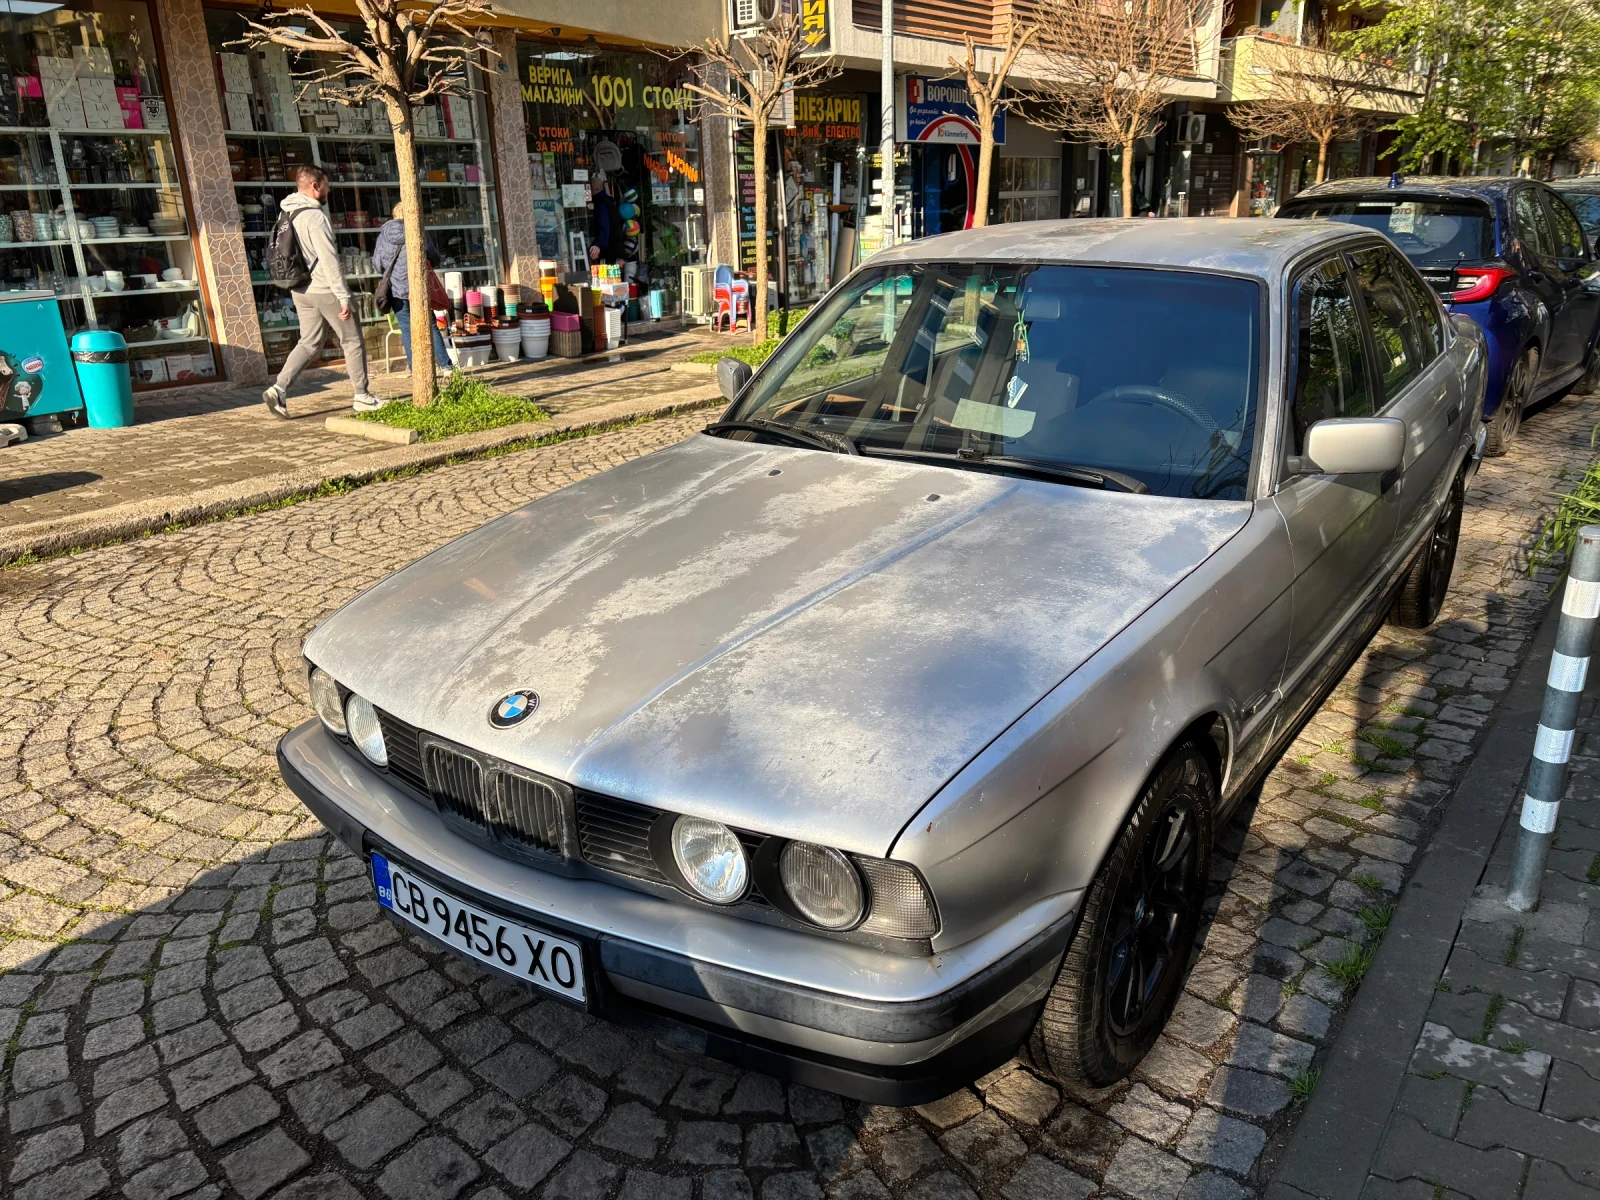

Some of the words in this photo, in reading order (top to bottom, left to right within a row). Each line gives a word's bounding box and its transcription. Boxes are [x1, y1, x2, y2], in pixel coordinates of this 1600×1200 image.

[803, 0, 826, 31] ИЯ
[528, 65, 574, 86] ВЕРИГА
[521, 84, 583, 106] МАГАЗИНИ
[591, 74, 634, 108] 1001
[643, 85, 693, 111] СТОКИ
[927, 85, 977, 105] ВОРОШИ
[794, 96, 861, 123] ЕЛЕЗАРИЯ
[538, 126, 570, 139] СТОКИ
[825, 125, 861, 138] ЕЛЕКТРО
[535, 141, 549, 152] ЗА
[550, 141, 575, 153] БИТА
[378, 885, 393, 901] BG
[392, 871, 429, 924] CB
[432, 896, 517, 967] 9456
[522, 933, 576, 989] XO
